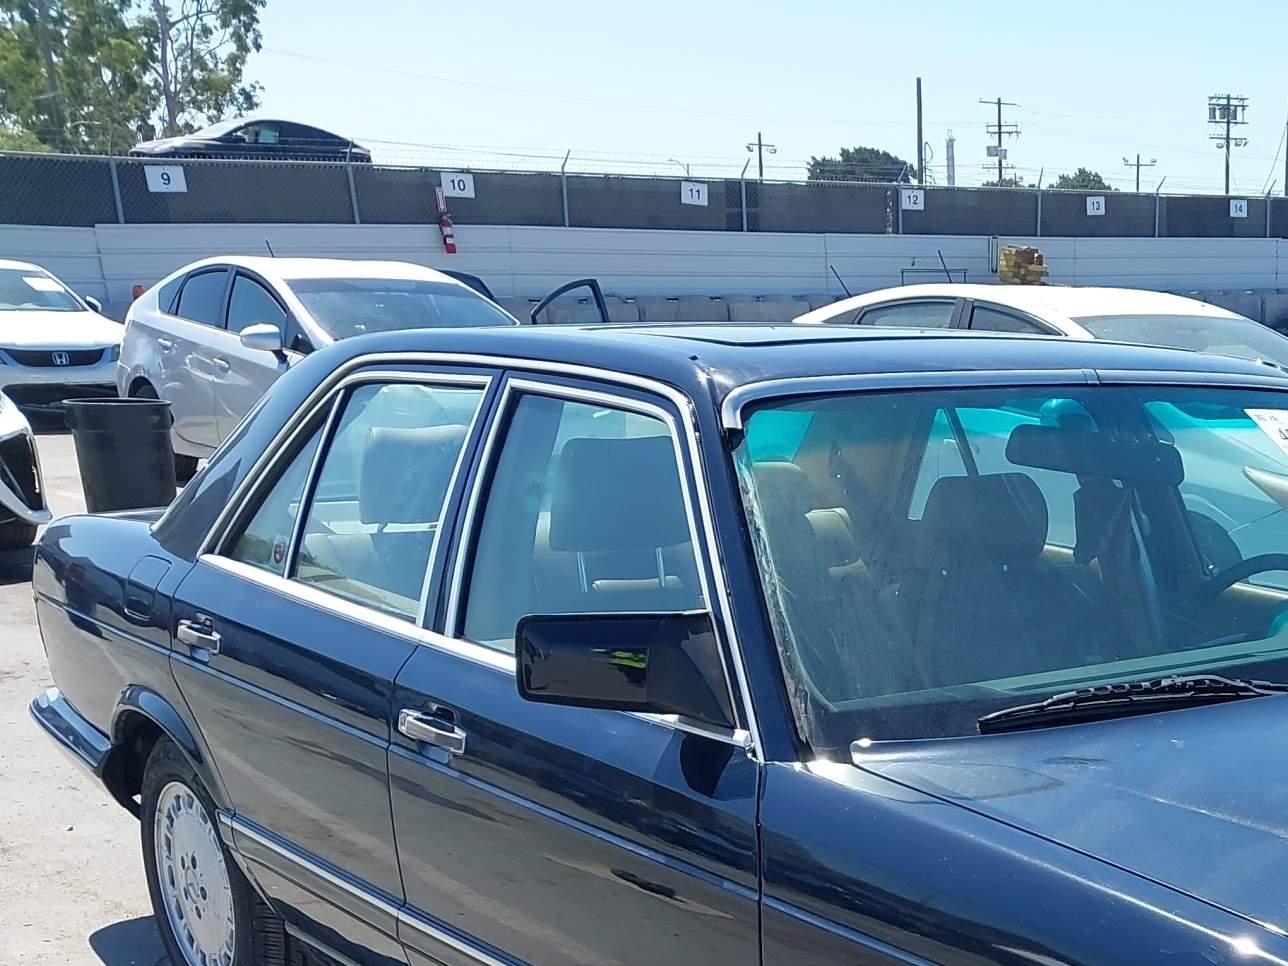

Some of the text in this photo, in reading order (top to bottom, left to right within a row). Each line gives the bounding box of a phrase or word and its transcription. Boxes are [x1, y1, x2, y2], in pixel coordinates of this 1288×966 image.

[160, 172, 171, 186] 9
[450, 178, 466, 192] 10
[689, 188, 700, 200] 11
[907, 194, 919, 205] 12
[1092, 200, 1101, 211] 13
